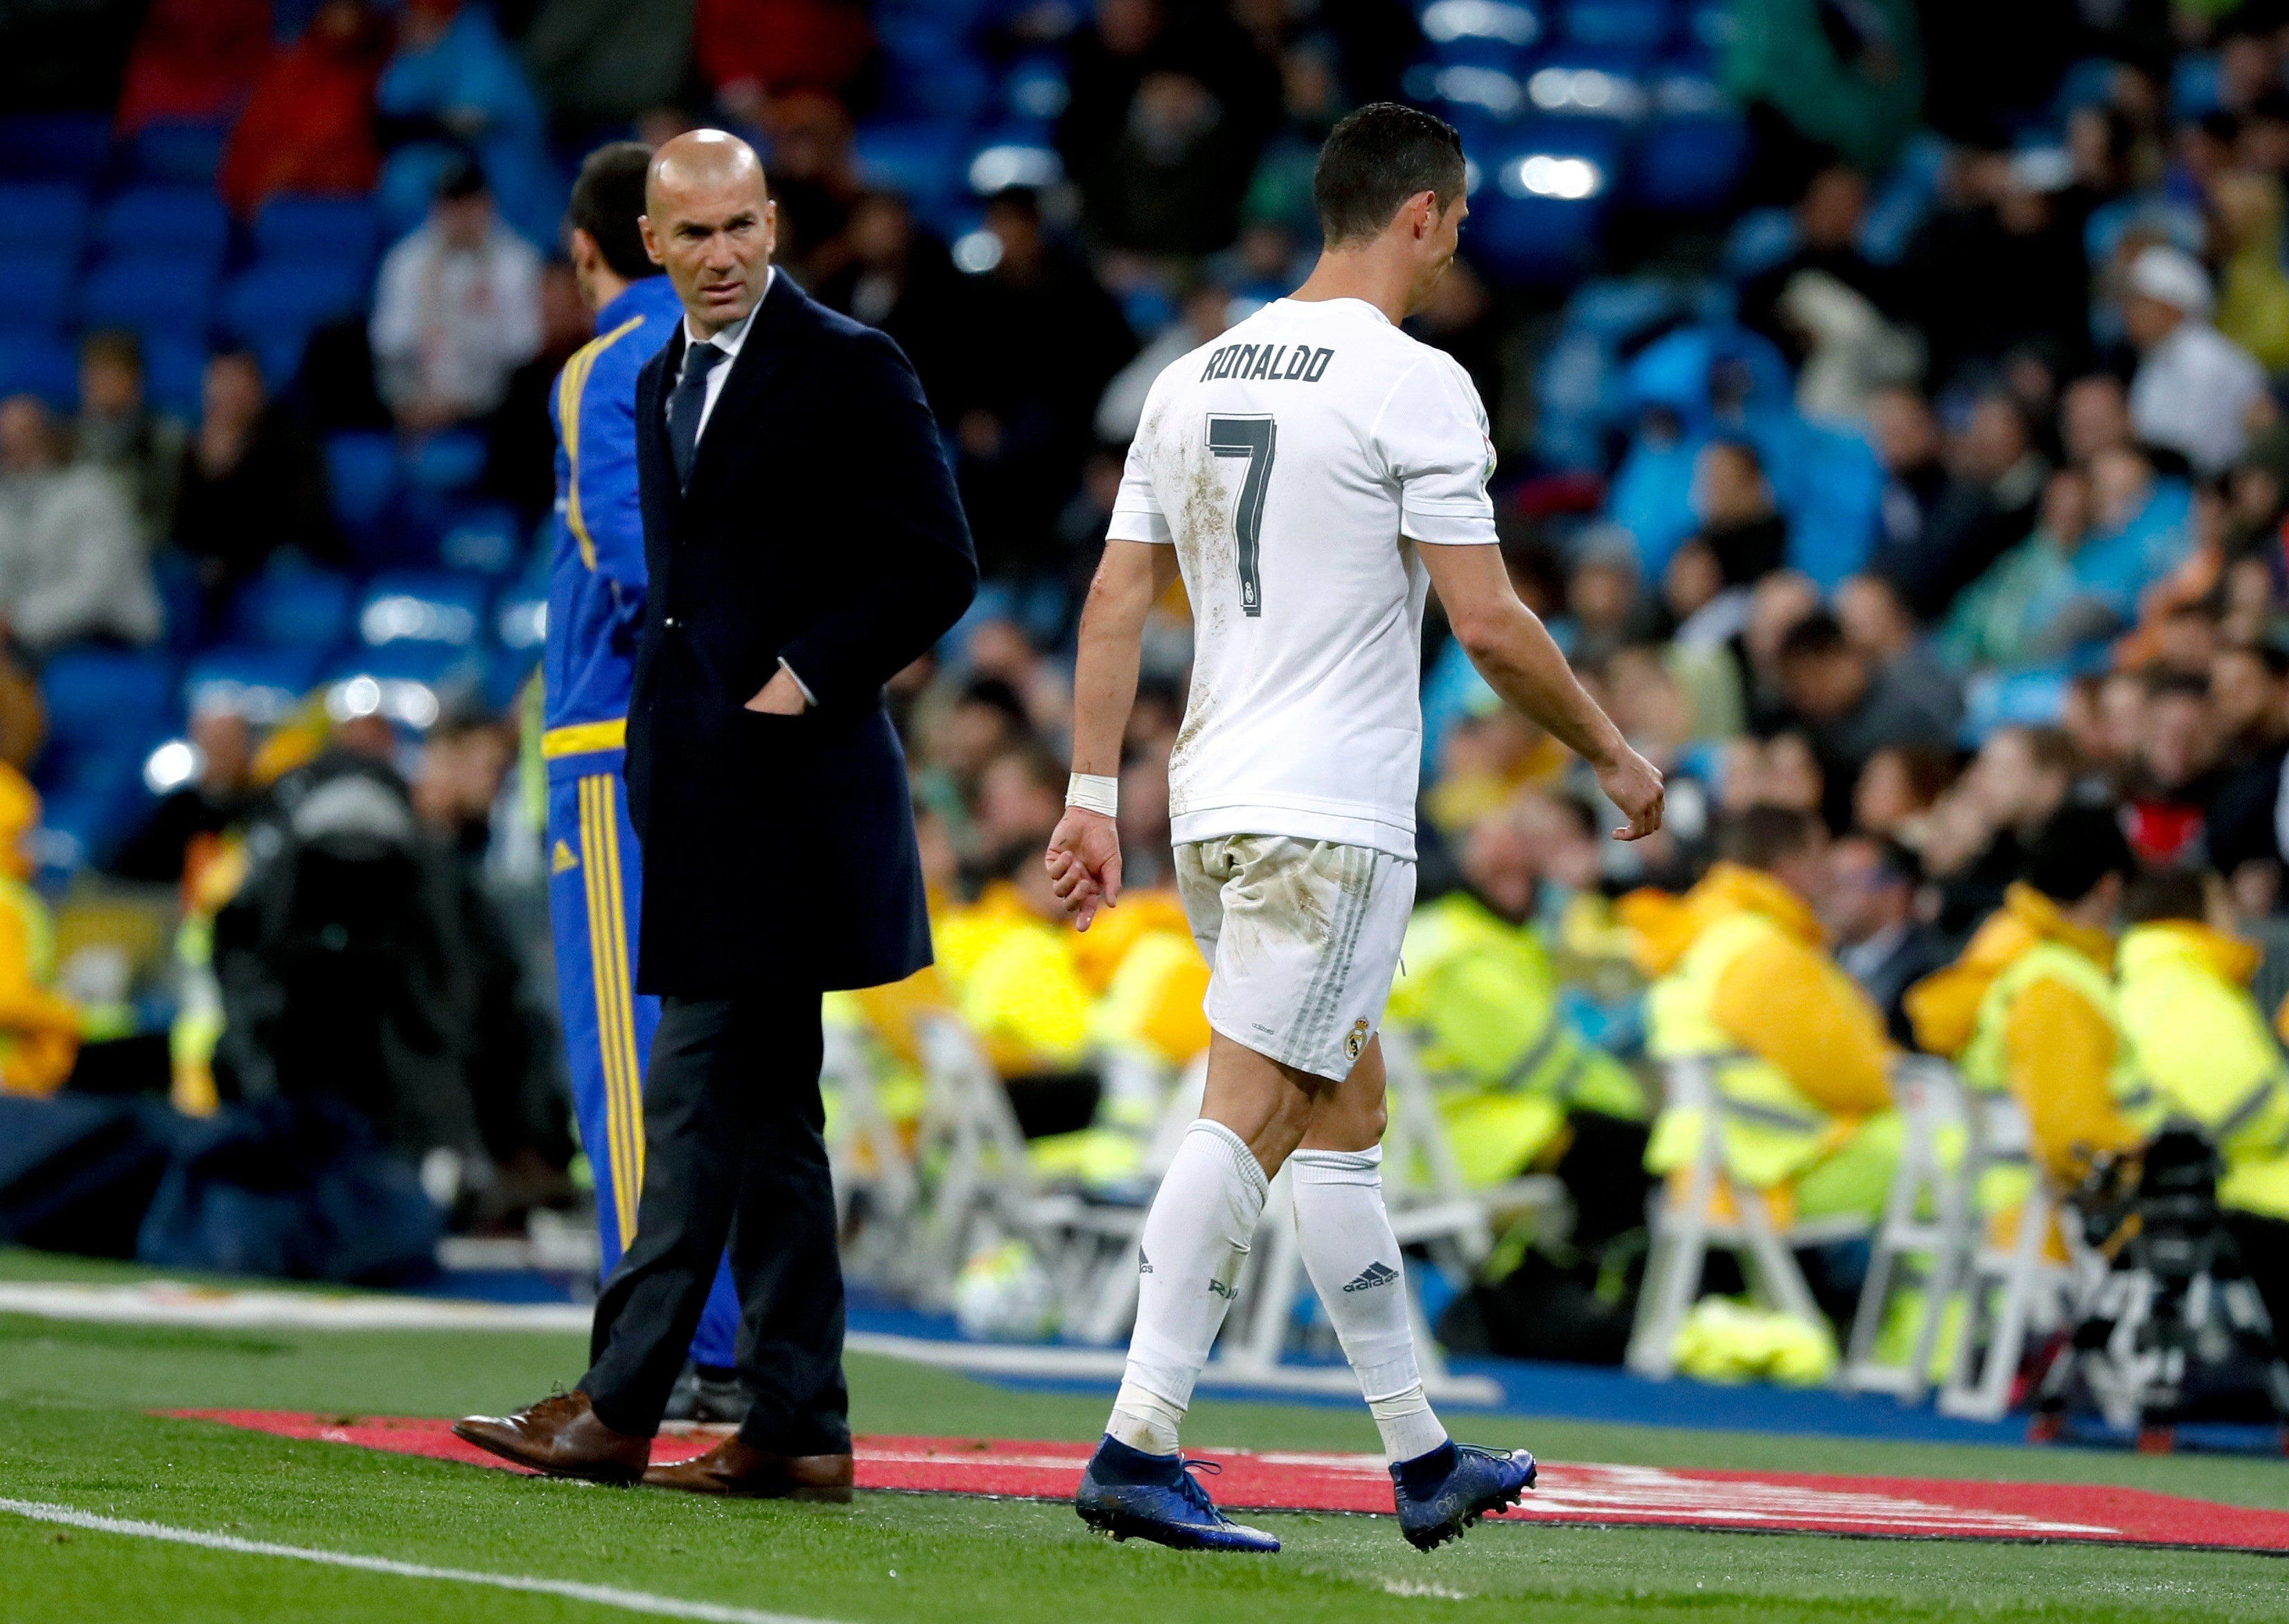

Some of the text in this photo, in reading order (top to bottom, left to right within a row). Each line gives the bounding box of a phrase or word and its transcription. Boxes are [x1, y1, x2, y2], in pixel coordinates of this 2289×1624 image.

[1199, 344, 1335, 382] RONALDO
[1205, 413, 1278, 617] 7
[1343, 1270, 1399, 1292] adidas
